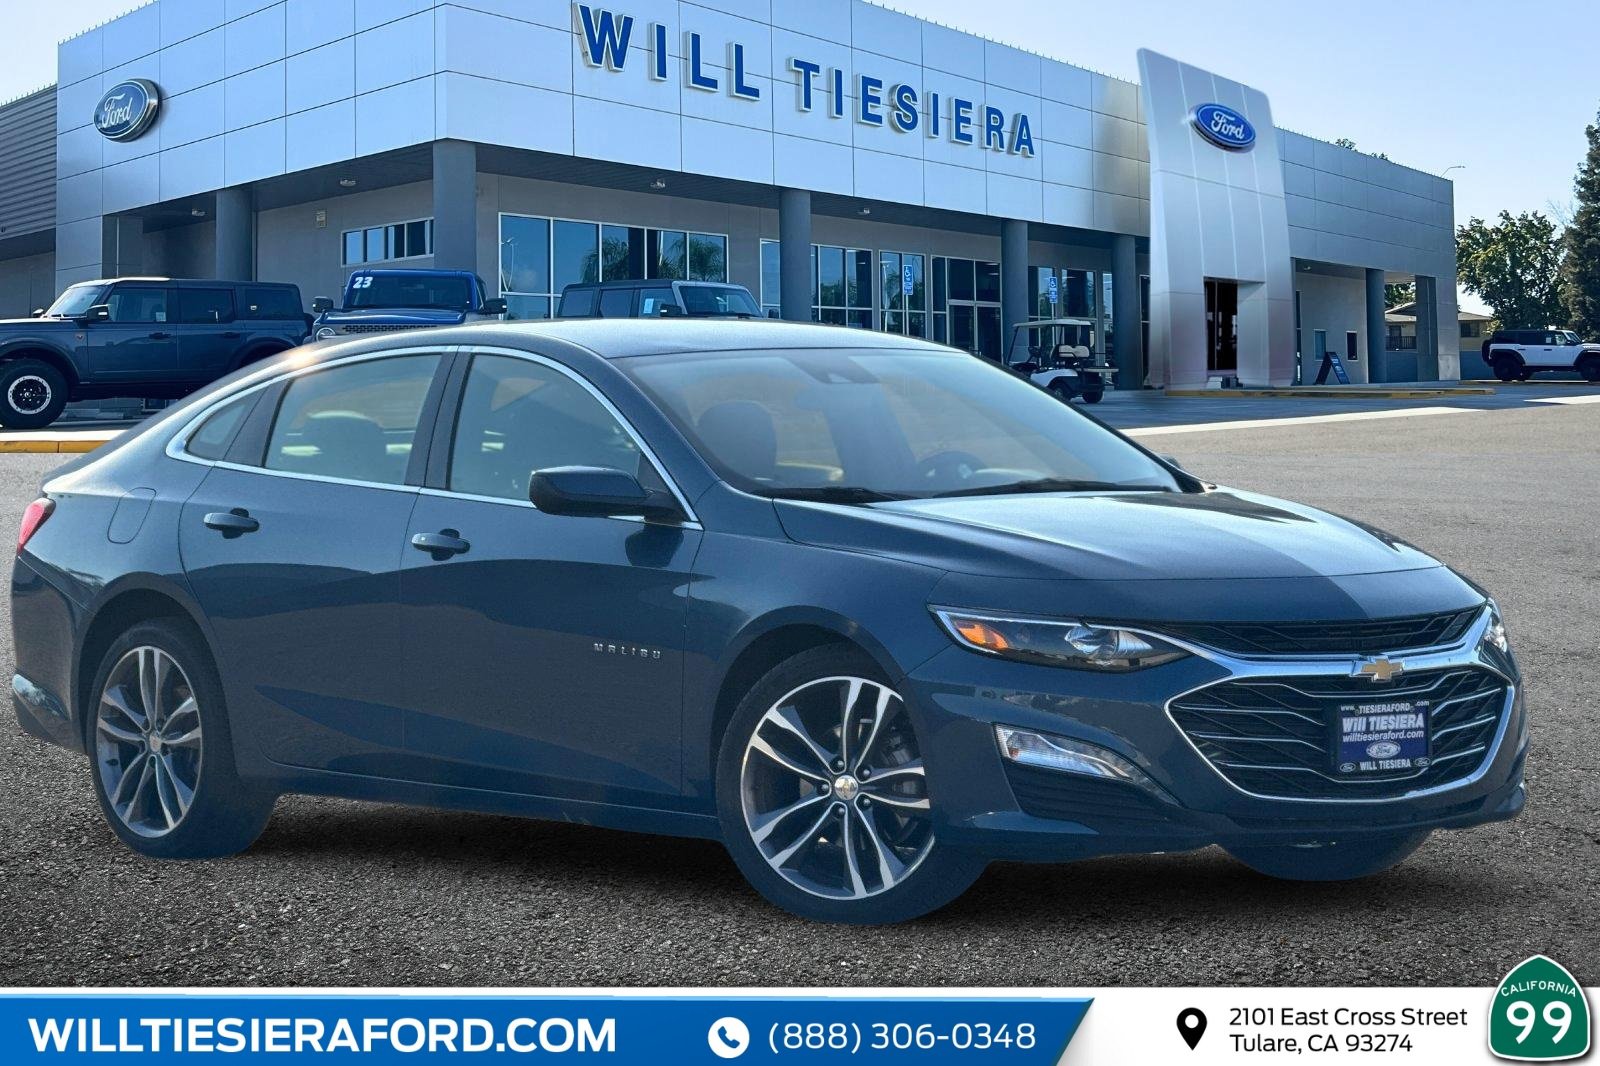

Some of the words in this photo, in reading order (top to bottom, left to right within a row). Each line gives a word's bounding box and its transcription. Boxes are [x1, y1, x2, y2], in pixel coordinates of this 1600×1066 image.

[575, 3, 760, 101] WILL
[790, 57, 1036, 158] TIESIERA
[101, 93, 133, 128] Ford
[1211, 110, 1244, 139] Ford
[352, 276, 373, 289] 23
[593, 643, 661, 659] MALIBU
[1359, 702, 1410, 714] TIESIERAFORD
[1368, 713, 1425, 731] TIESIERA
[1342, 730, 1425, 743] willtiesieraford.com
[1360, 761, 1378, 770] WILL
[1379, 759, 1411, 769] TIESIERA
